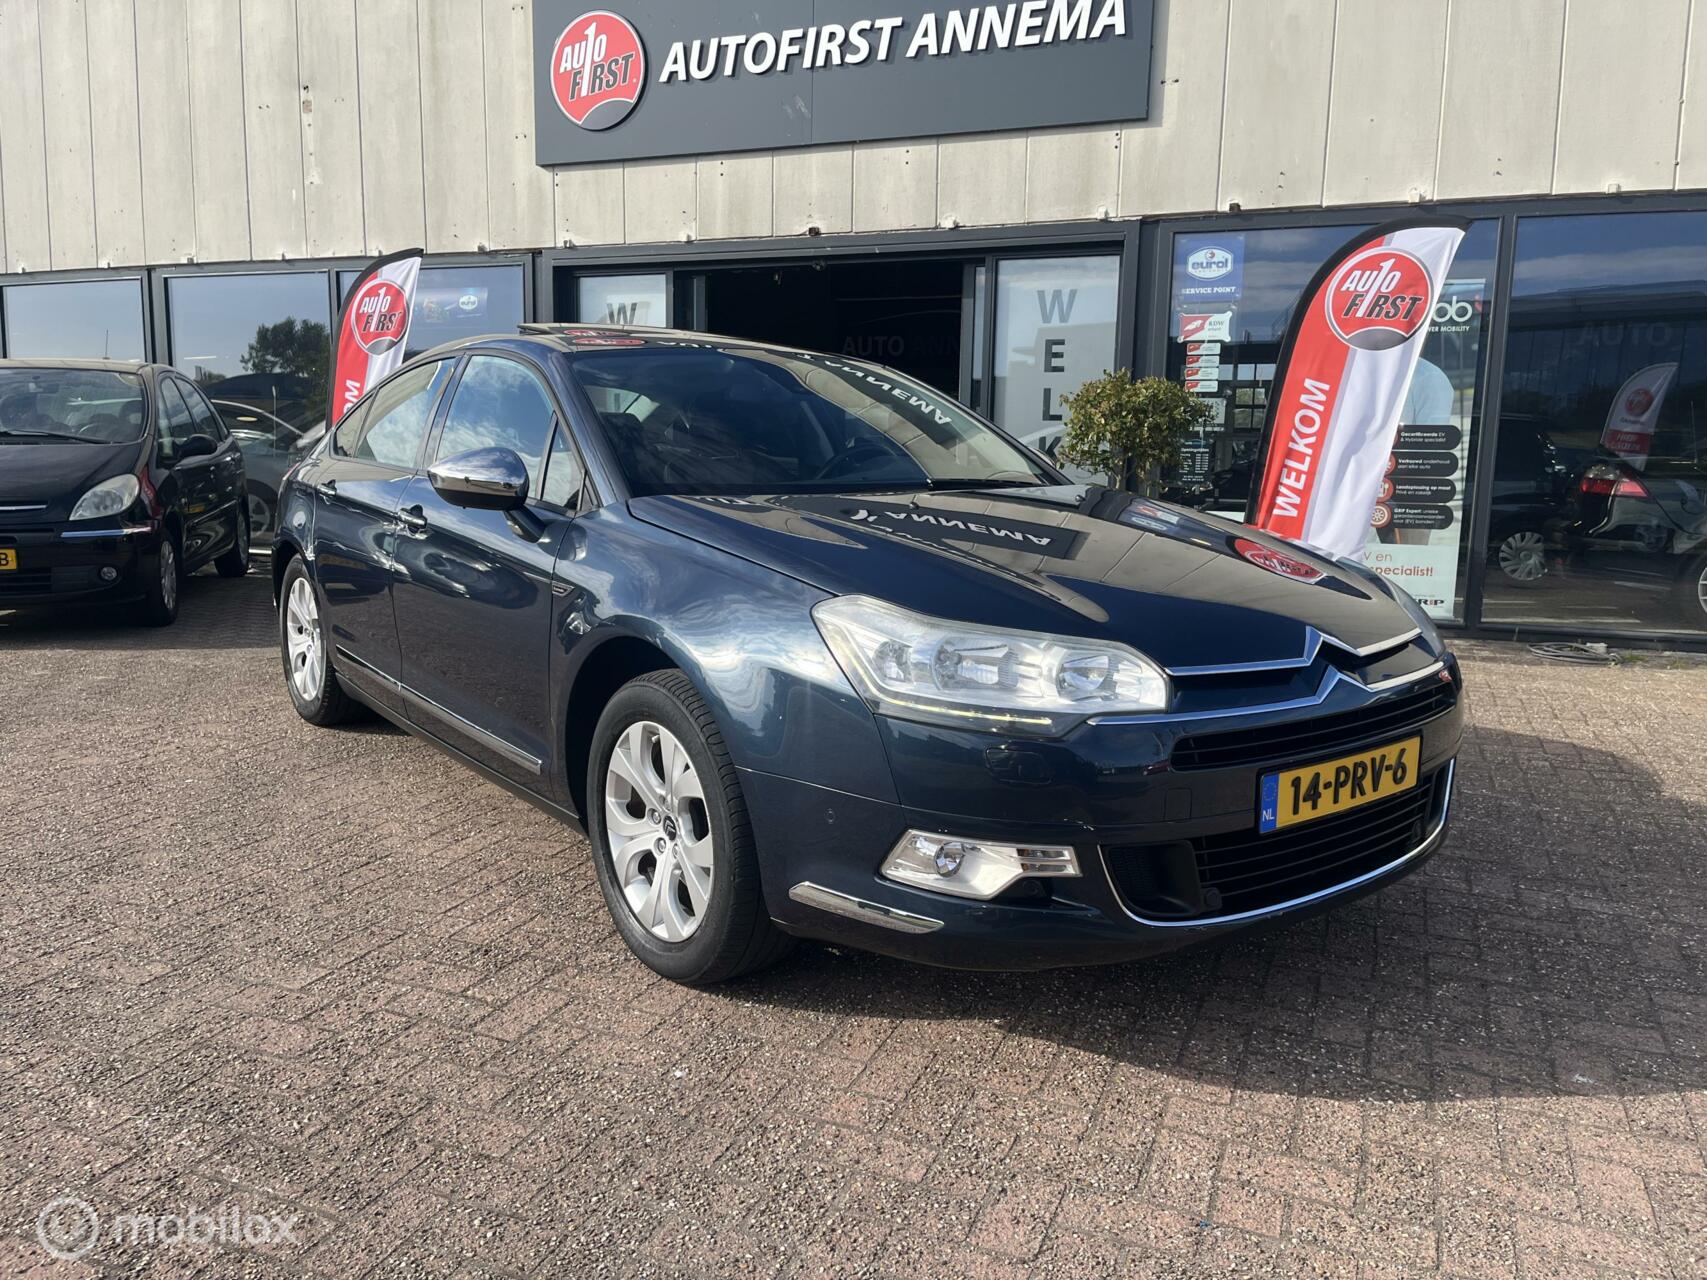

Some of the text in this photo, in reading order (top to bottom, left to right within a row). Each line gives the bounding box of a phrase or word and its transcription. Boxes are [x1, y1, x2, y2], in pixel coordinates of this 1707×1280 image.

[658, 0, 1126, 83] AUTOFIRST ANNEMA
[1191, 257, 1228, 270] eurol
[1181, 287, 1212, 295] SERVICE
[1273, 378, 1331, 518] WELKOM
[1376, 553, 1392, 561] en
[1291, 748, 1407, 815] 14-PRV-6
[1262, 809, 1275, 822] NL
